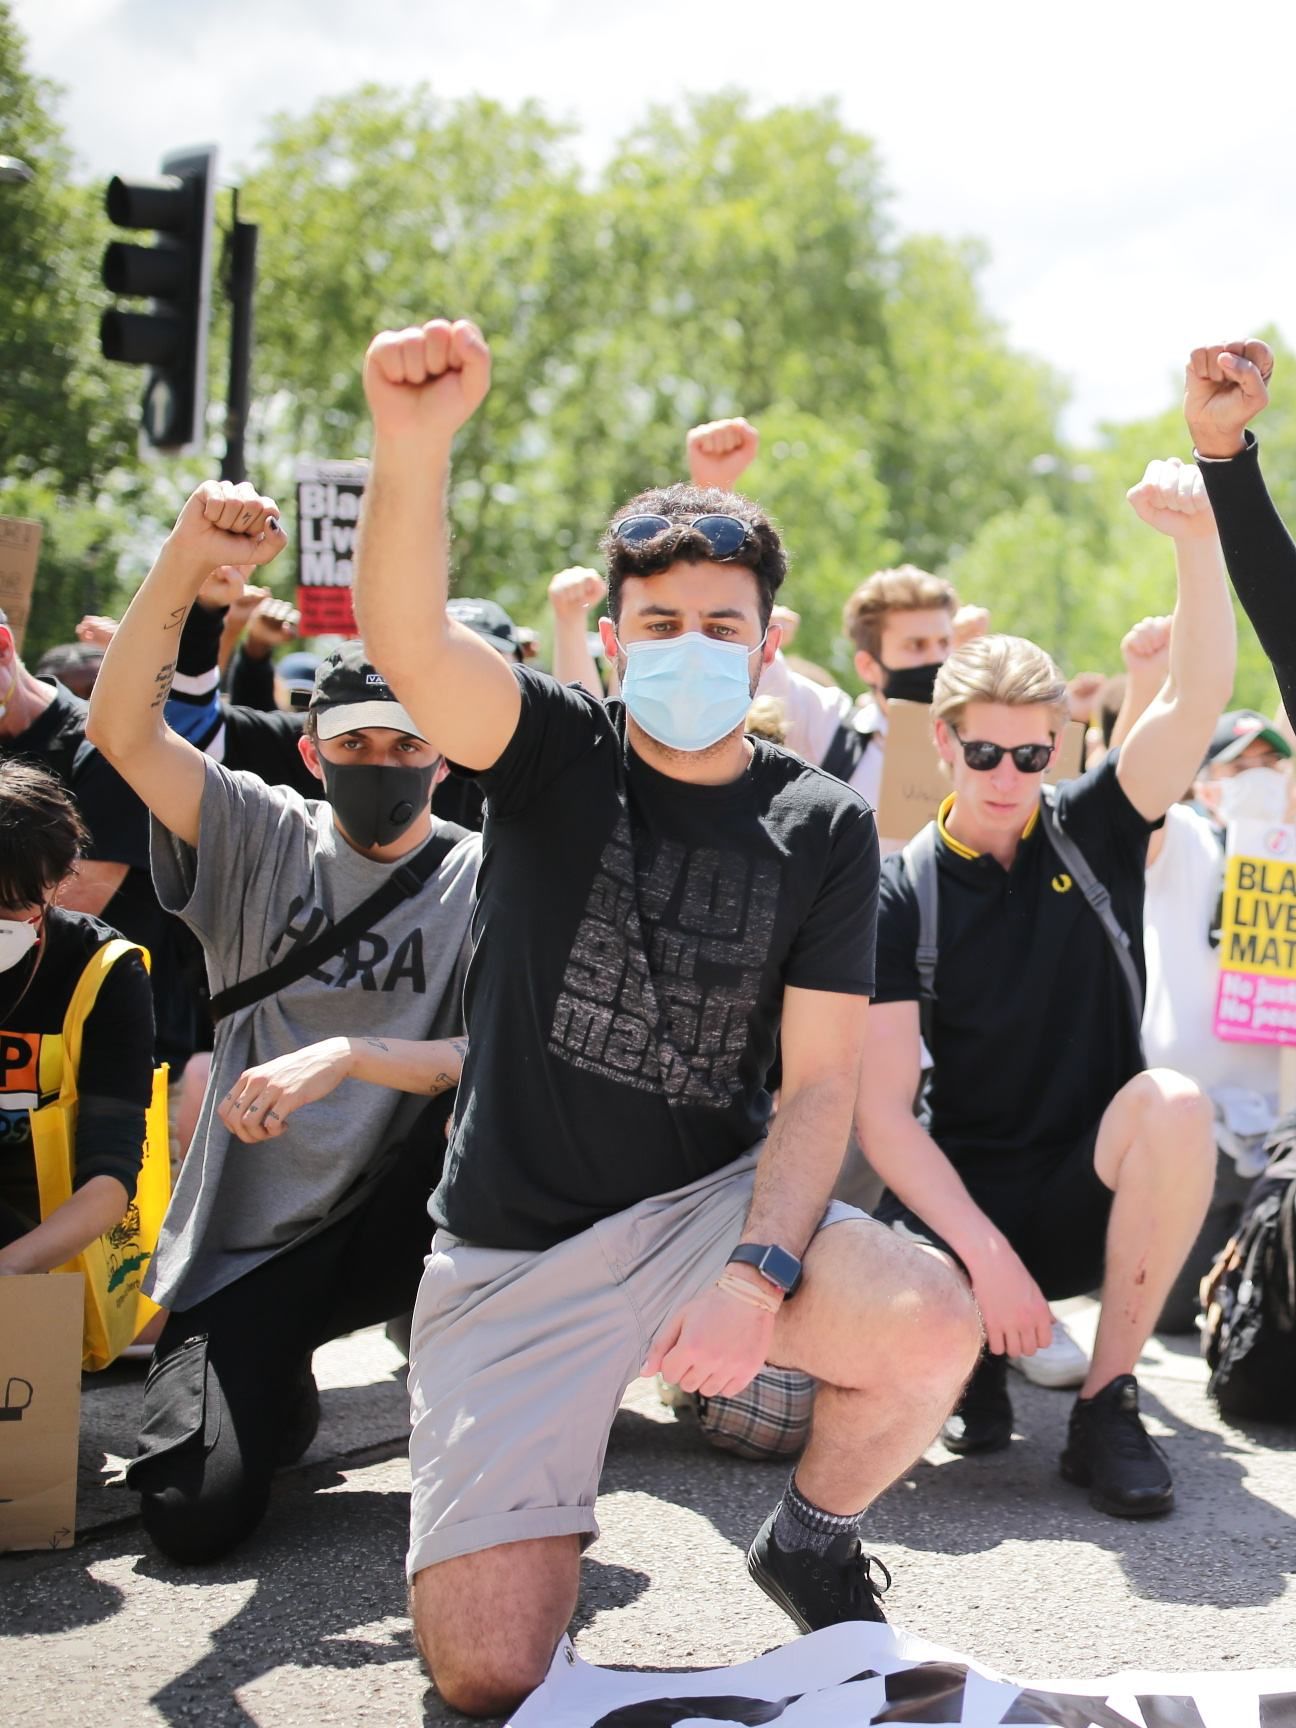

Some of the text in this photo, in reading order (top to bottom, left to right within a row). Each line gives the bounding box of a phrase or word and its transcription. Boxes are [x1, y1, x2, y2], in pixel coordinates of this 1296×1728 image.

[301, 483, 362, 519] Bla
[301, 518, 357, 553] Liv
[1219, 998, 1251, 1022] No
